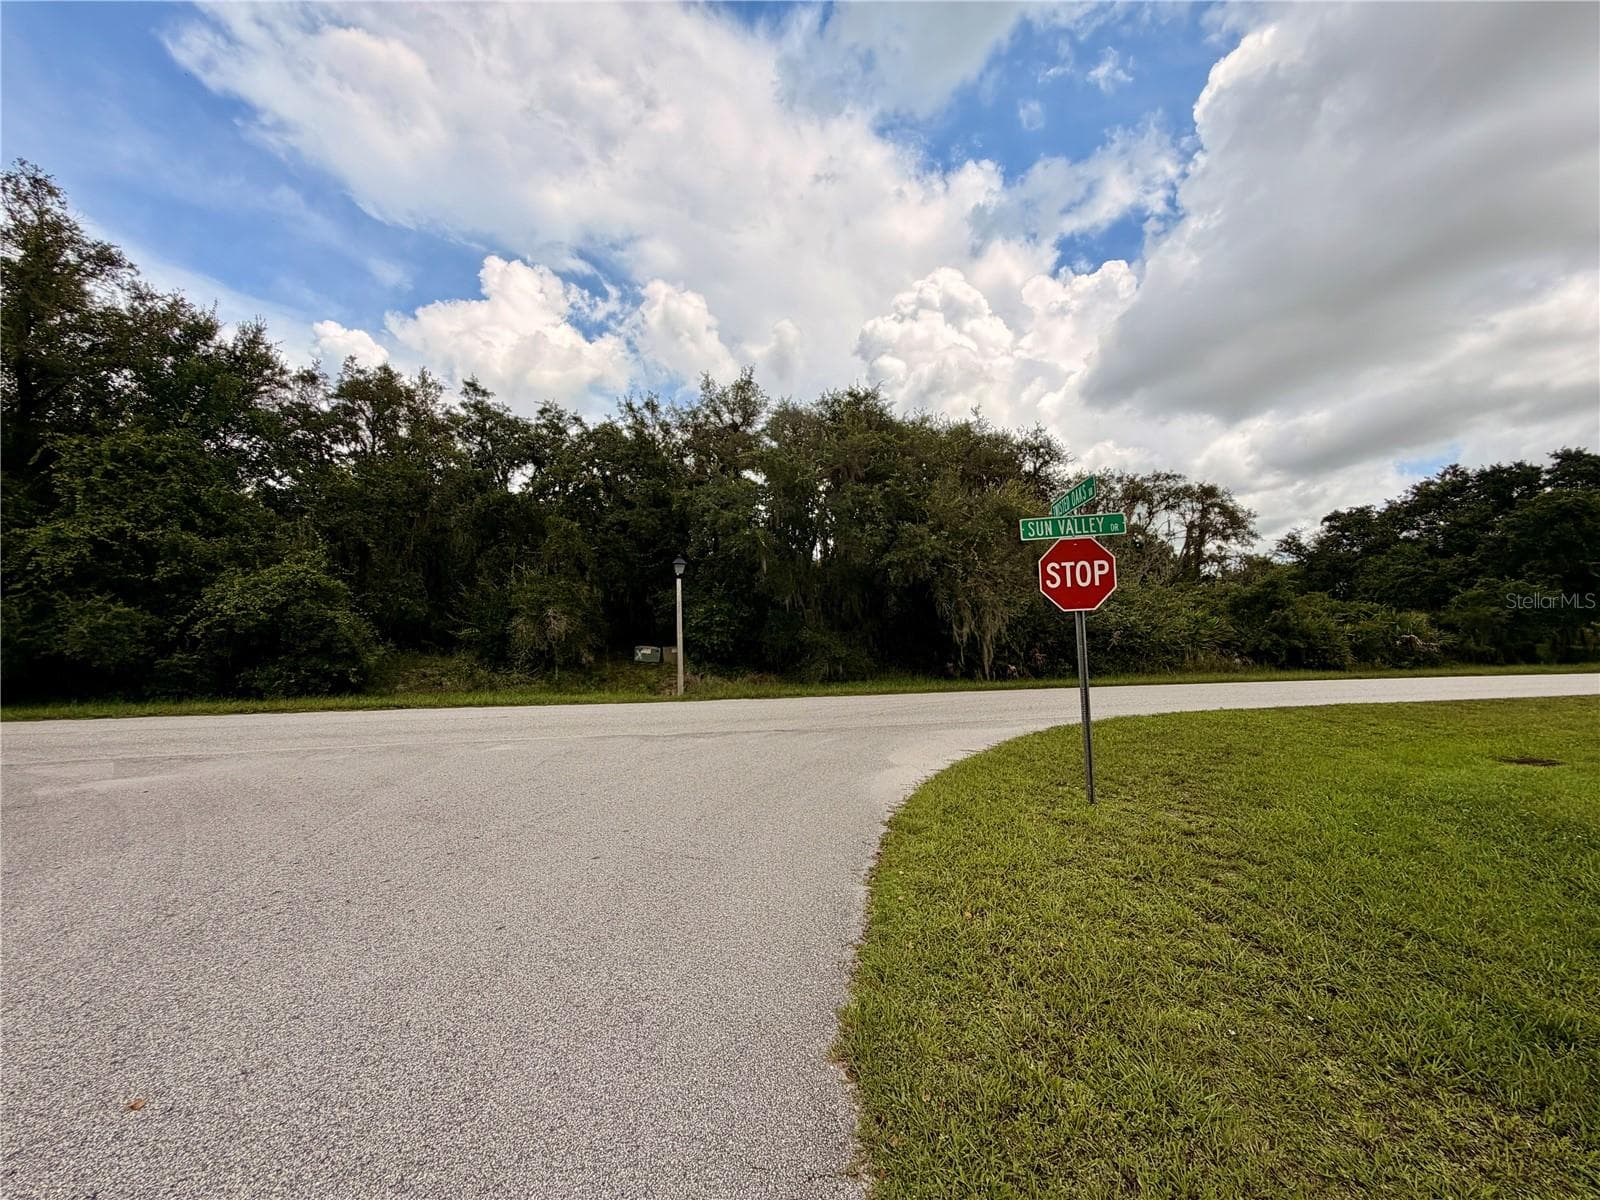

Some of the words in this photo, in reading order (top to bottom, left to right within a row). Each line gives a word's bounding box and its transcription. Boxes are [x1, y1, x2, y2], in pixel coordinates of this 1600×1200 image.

[1071, 485, 1087, 507] OAKS
[1028, 520, 1053, 537] SUN
[1058, 517, 1104, 535] VALLEY
[1110, 523, 1119, 532] DR
[1046, 560, 1109, 589] STOP
